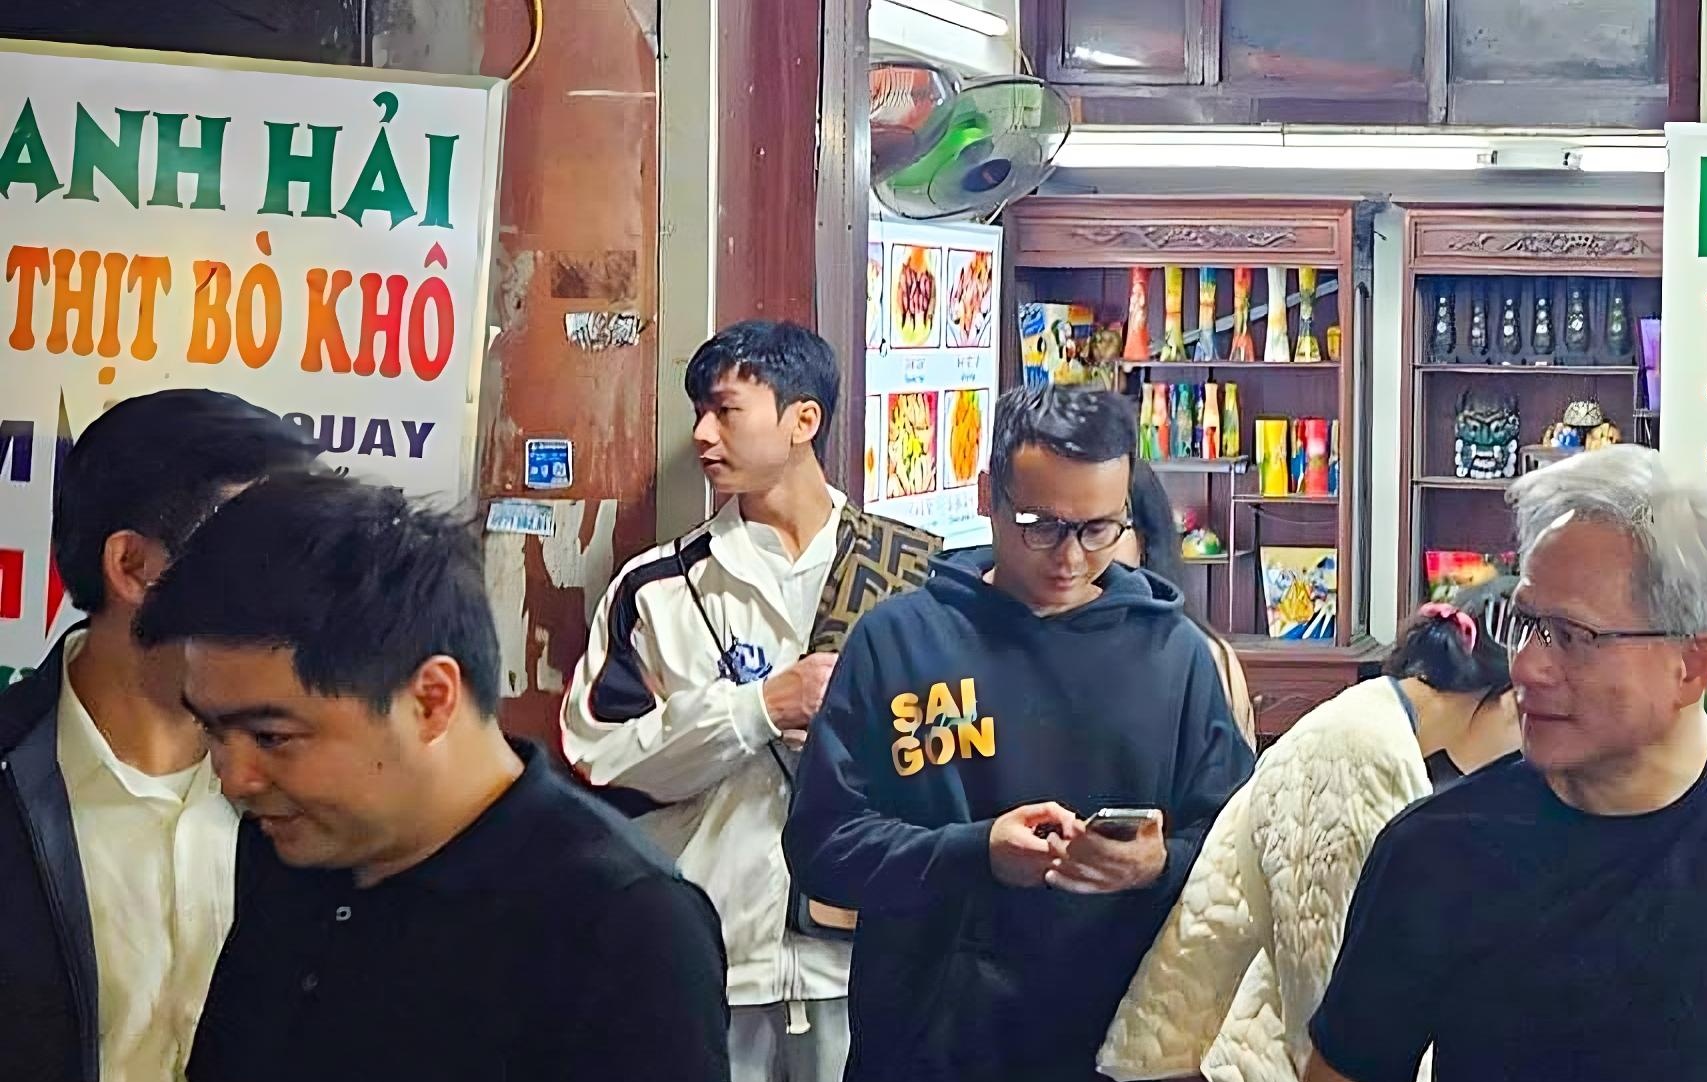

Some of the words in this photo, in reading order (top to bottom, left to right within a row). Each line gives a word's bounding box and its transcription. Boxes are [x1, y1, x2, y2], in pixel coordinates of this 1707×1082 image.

[0, 97, 231, 211] ANH
[257, 91, 460, 231] HẢI
[6, 245, 172, 384] THỊT
[186, 231, 282, 369] BÒ
[300, 241, 455, 382] KHÔ
[890, 678, 977, 733] SAI
[891, 716, 996, 777] GON
